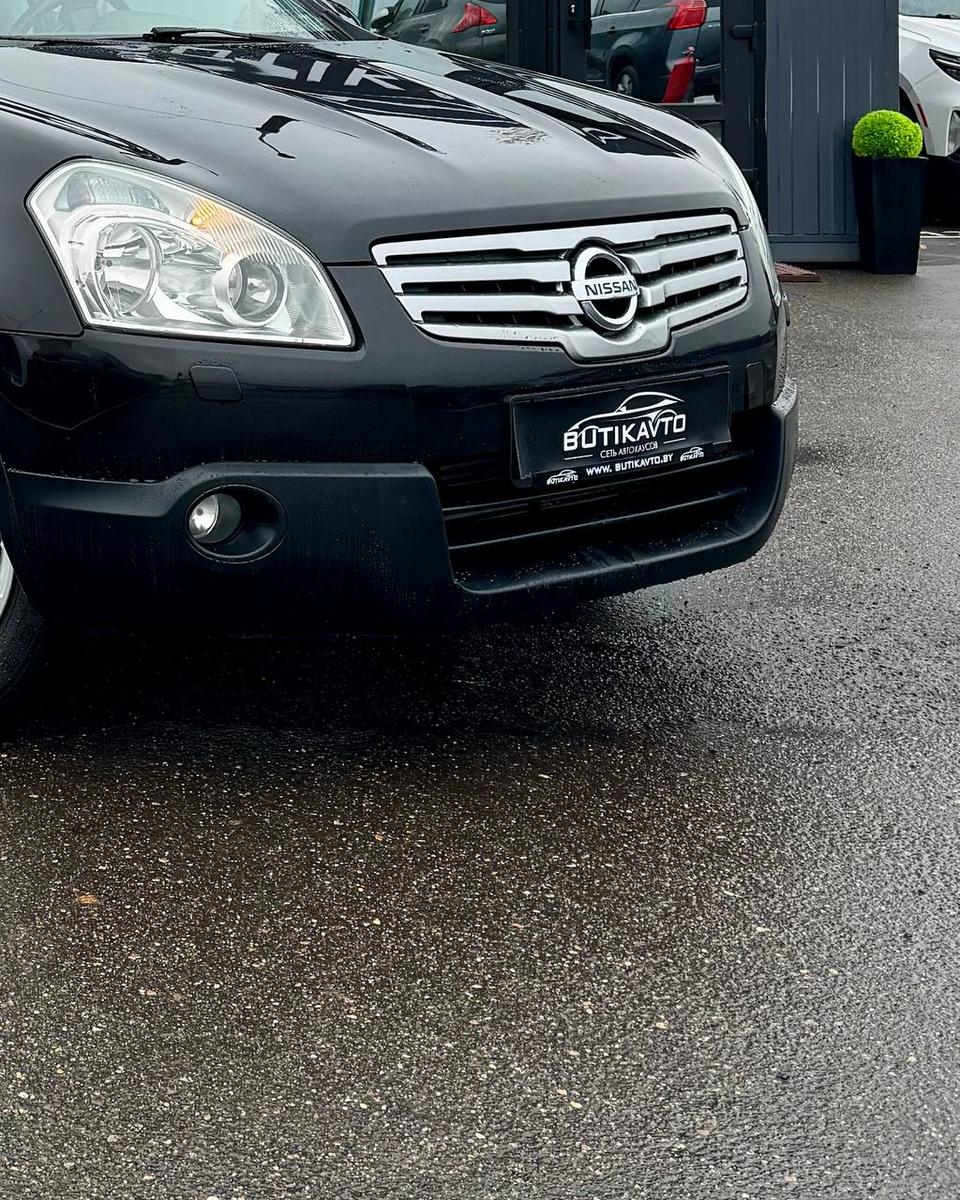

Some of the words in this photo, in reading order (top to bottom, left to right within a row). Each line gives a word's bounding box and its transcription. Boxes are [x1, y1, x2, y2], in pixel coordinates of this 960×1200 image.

[585, 280, 638, 297] NISSAN
[563, 413, 686, 452] BUTIKAVTO
[615, 453, 674, 472] BUTIKAVTO.BY
